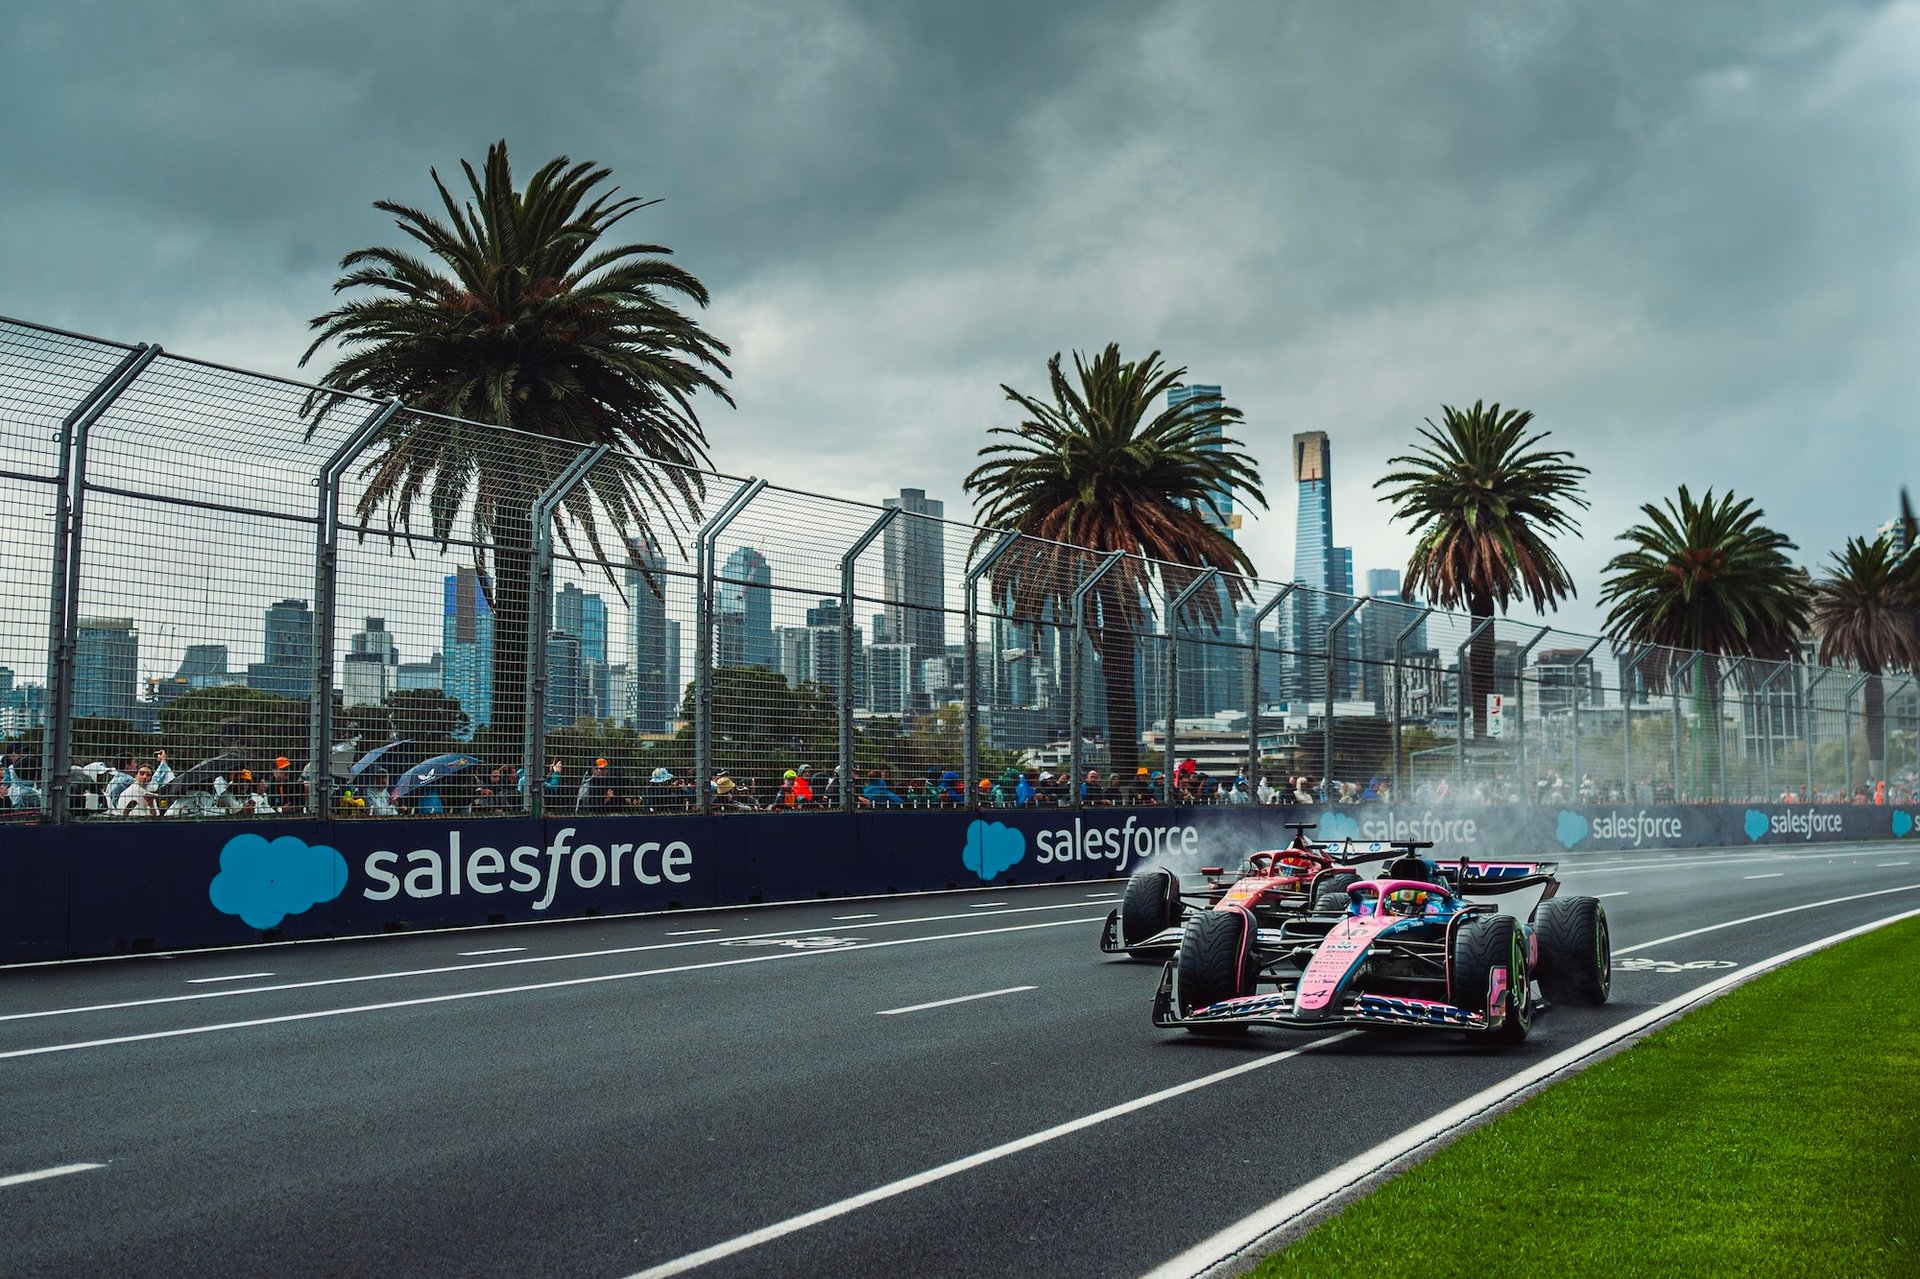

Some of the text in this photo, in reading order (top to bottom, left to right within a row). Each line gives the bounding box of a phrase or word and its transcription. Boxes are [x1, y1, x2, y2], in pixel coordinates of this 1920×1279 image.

[1362, 811, 1477, 844] salesforce
[1593, 809, 1682, 846] salesforce
[1771, 808, 1842, 840] salesforce
[1036, 815, 1199, 871] salesforce
[363, 827, 693, 911] salesforce
